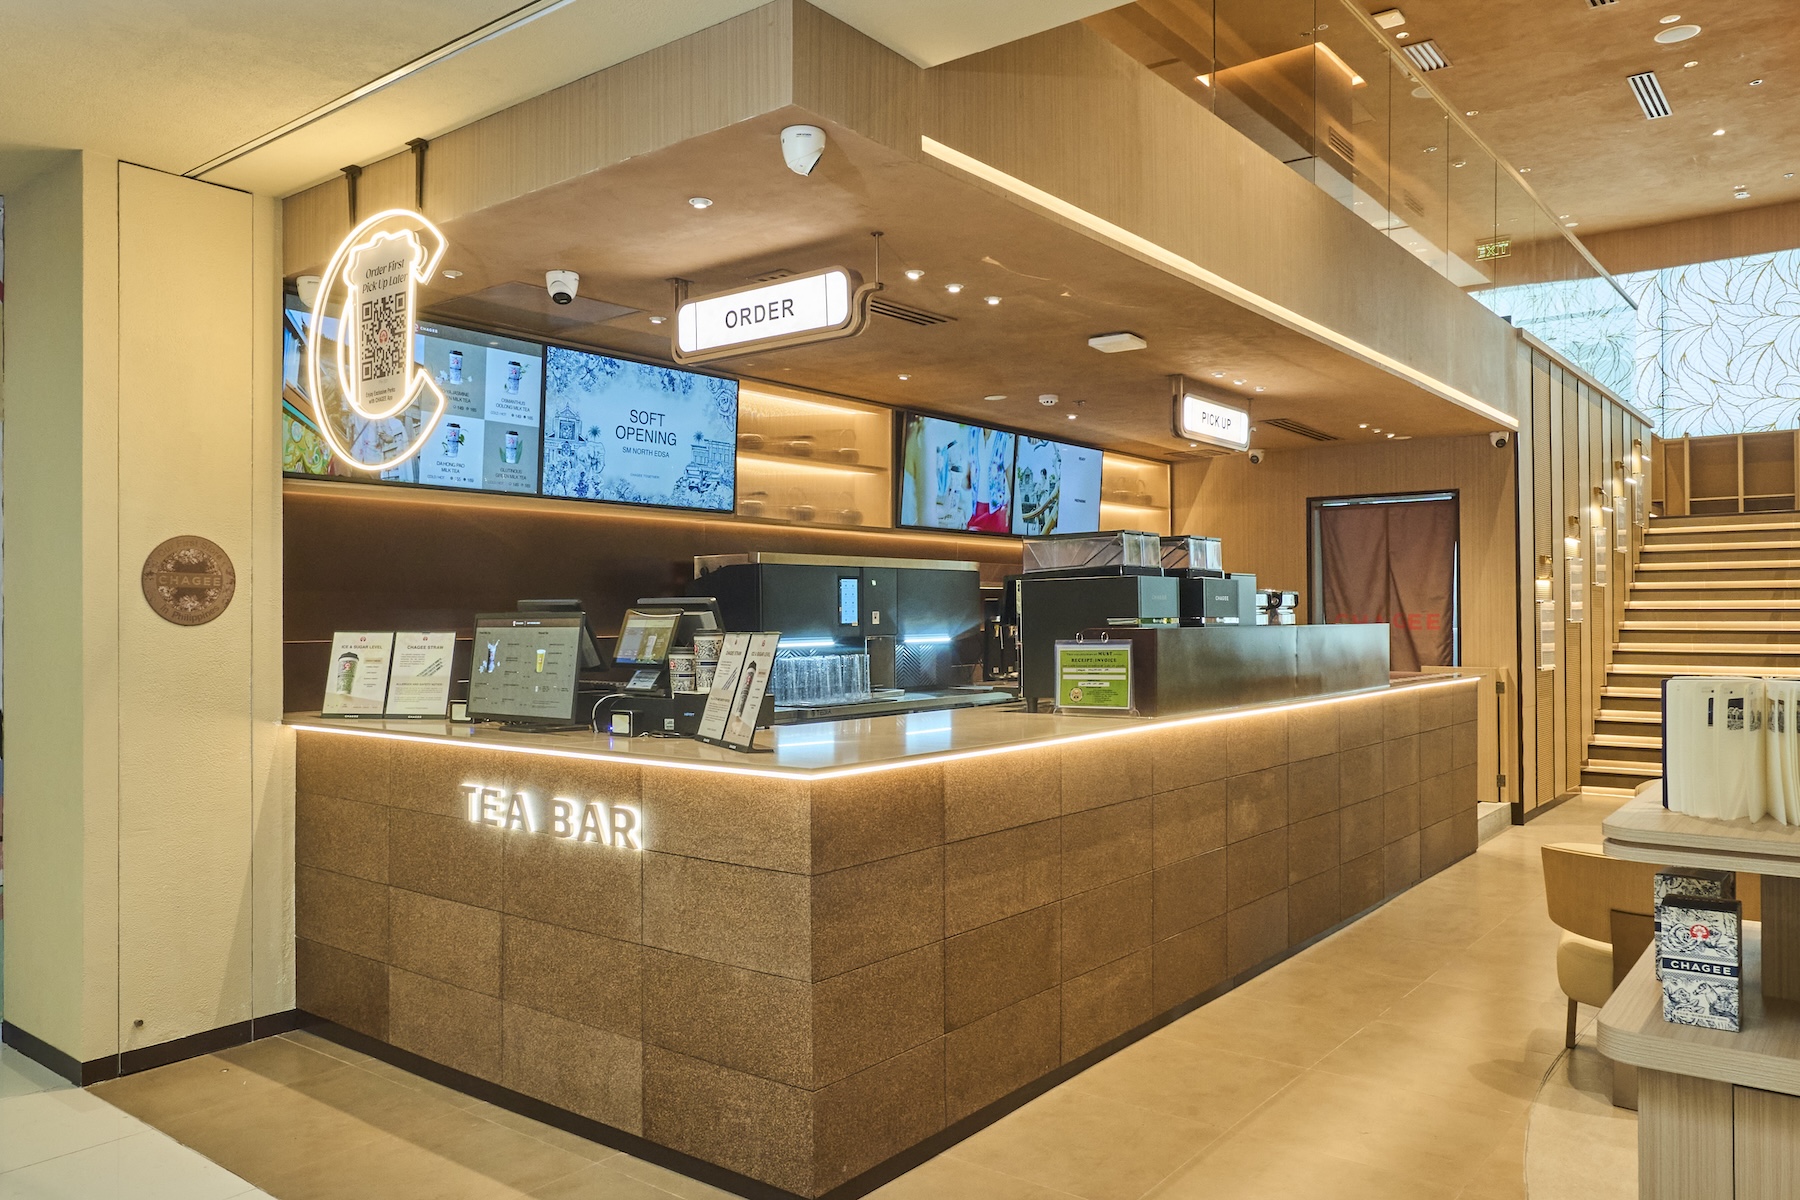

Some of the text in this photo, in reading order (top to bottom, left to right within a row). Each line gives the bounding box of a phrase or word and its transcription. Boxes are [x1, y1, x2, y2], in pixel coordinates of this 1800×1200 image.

[1477, 242, 1508, 258] EXIT
[365, 259, 404, 279] Order First
[362, 273, 408, 293] Pick Up Later
[725, 298, 795, 329] ORDER
[629, 409, 665, 427] SOFT
[1202, 411, 1231, 430] PICK UP
[615, 425, 677, 446] OPENING
[622, 446, 670, 458] SM NORTH EDSA
[158, 544, 174, 556] Our
[201, 542, 223, 559] Store
[159, 575, 221, 587] CHAGEE
[171, 605, 220, 623] Philippines
[461, 784, 641, 850] TEA BAR
[1670, 960, 1732, 976] CHAGEE
